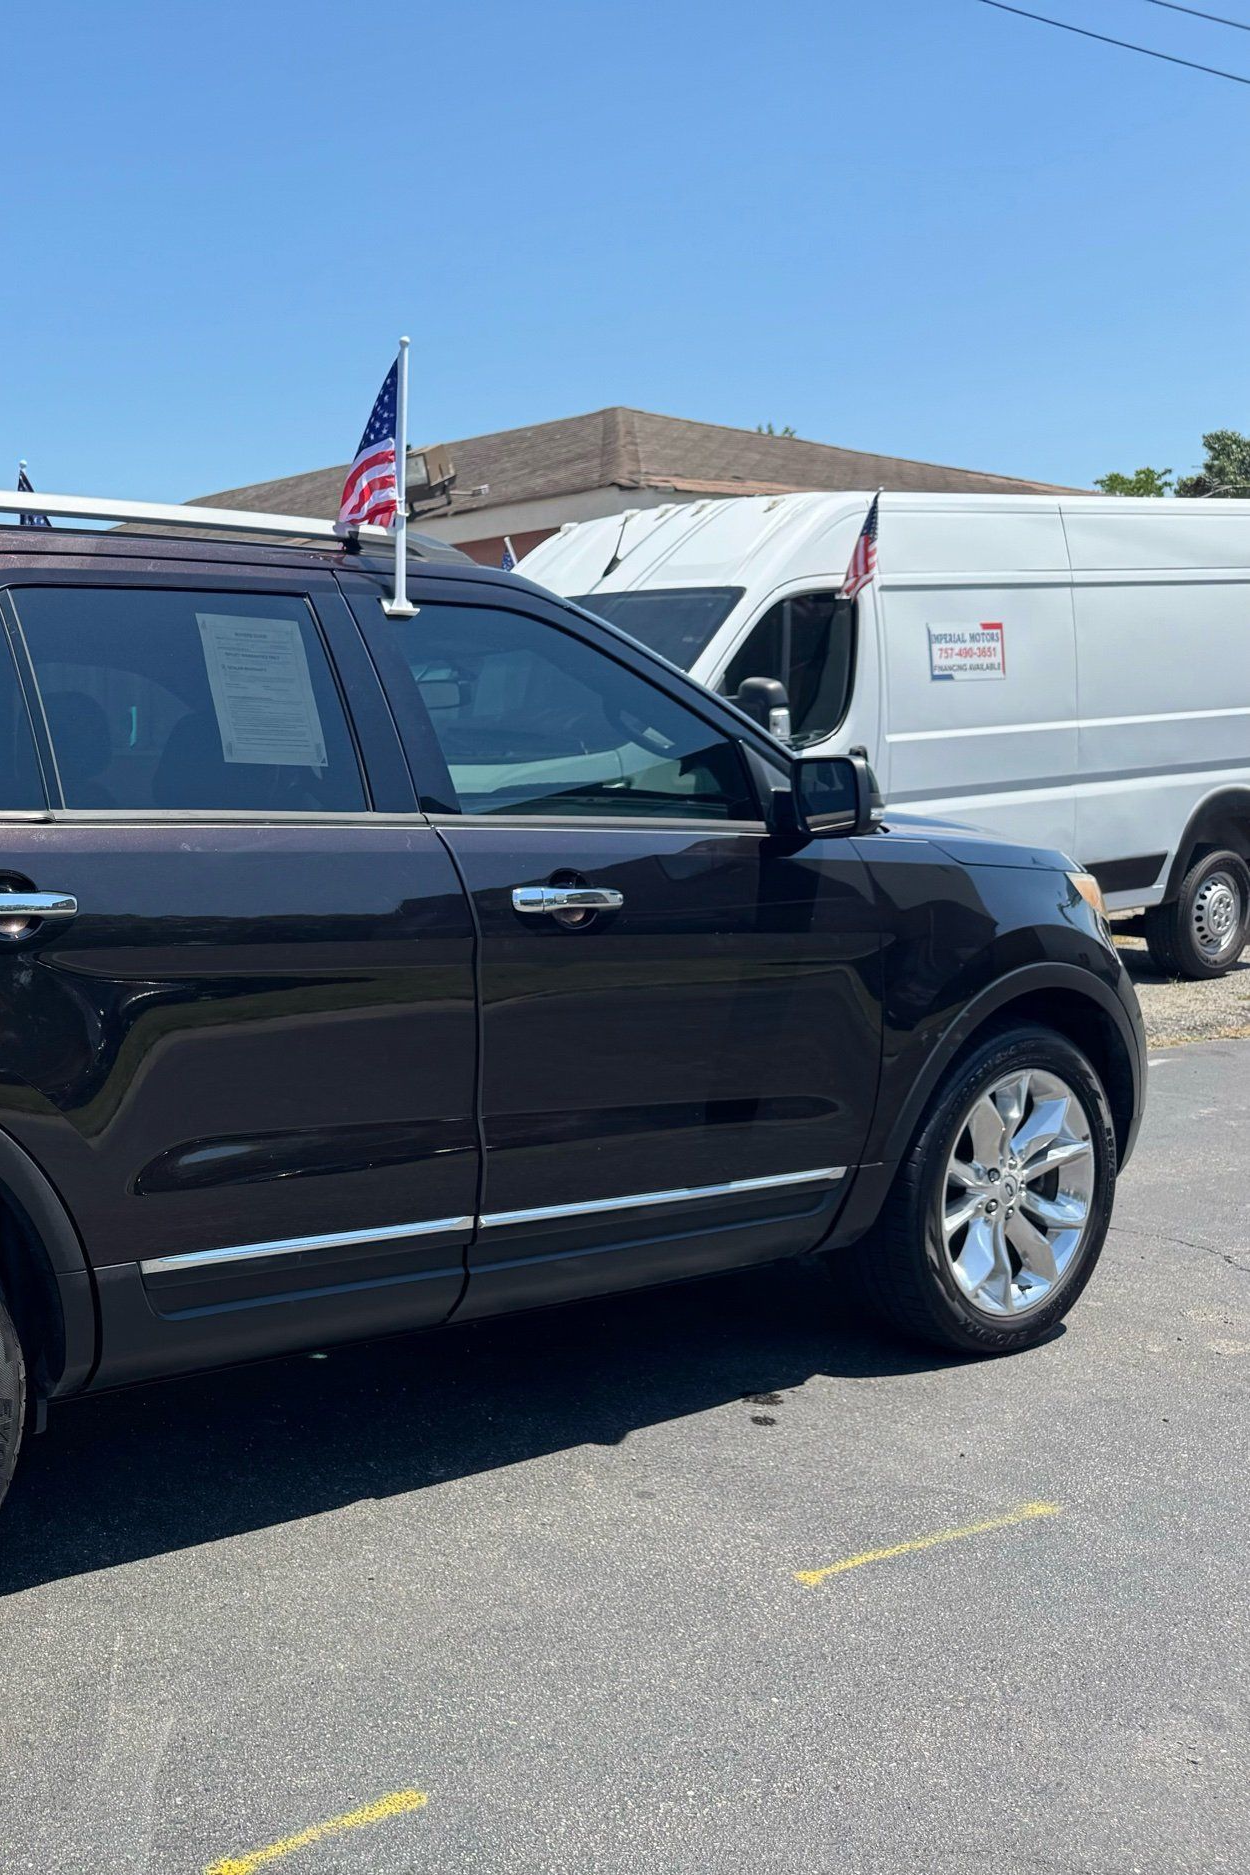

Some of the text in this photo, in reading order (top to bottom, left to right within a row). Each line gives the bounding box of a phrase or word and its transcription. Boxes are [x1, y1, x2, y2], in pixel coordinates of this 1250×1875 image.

[931, 632, 1000, 644] IMPERIAL MOTORS
[933, 662, 1001, 673] FINANCING AVAILABLE
